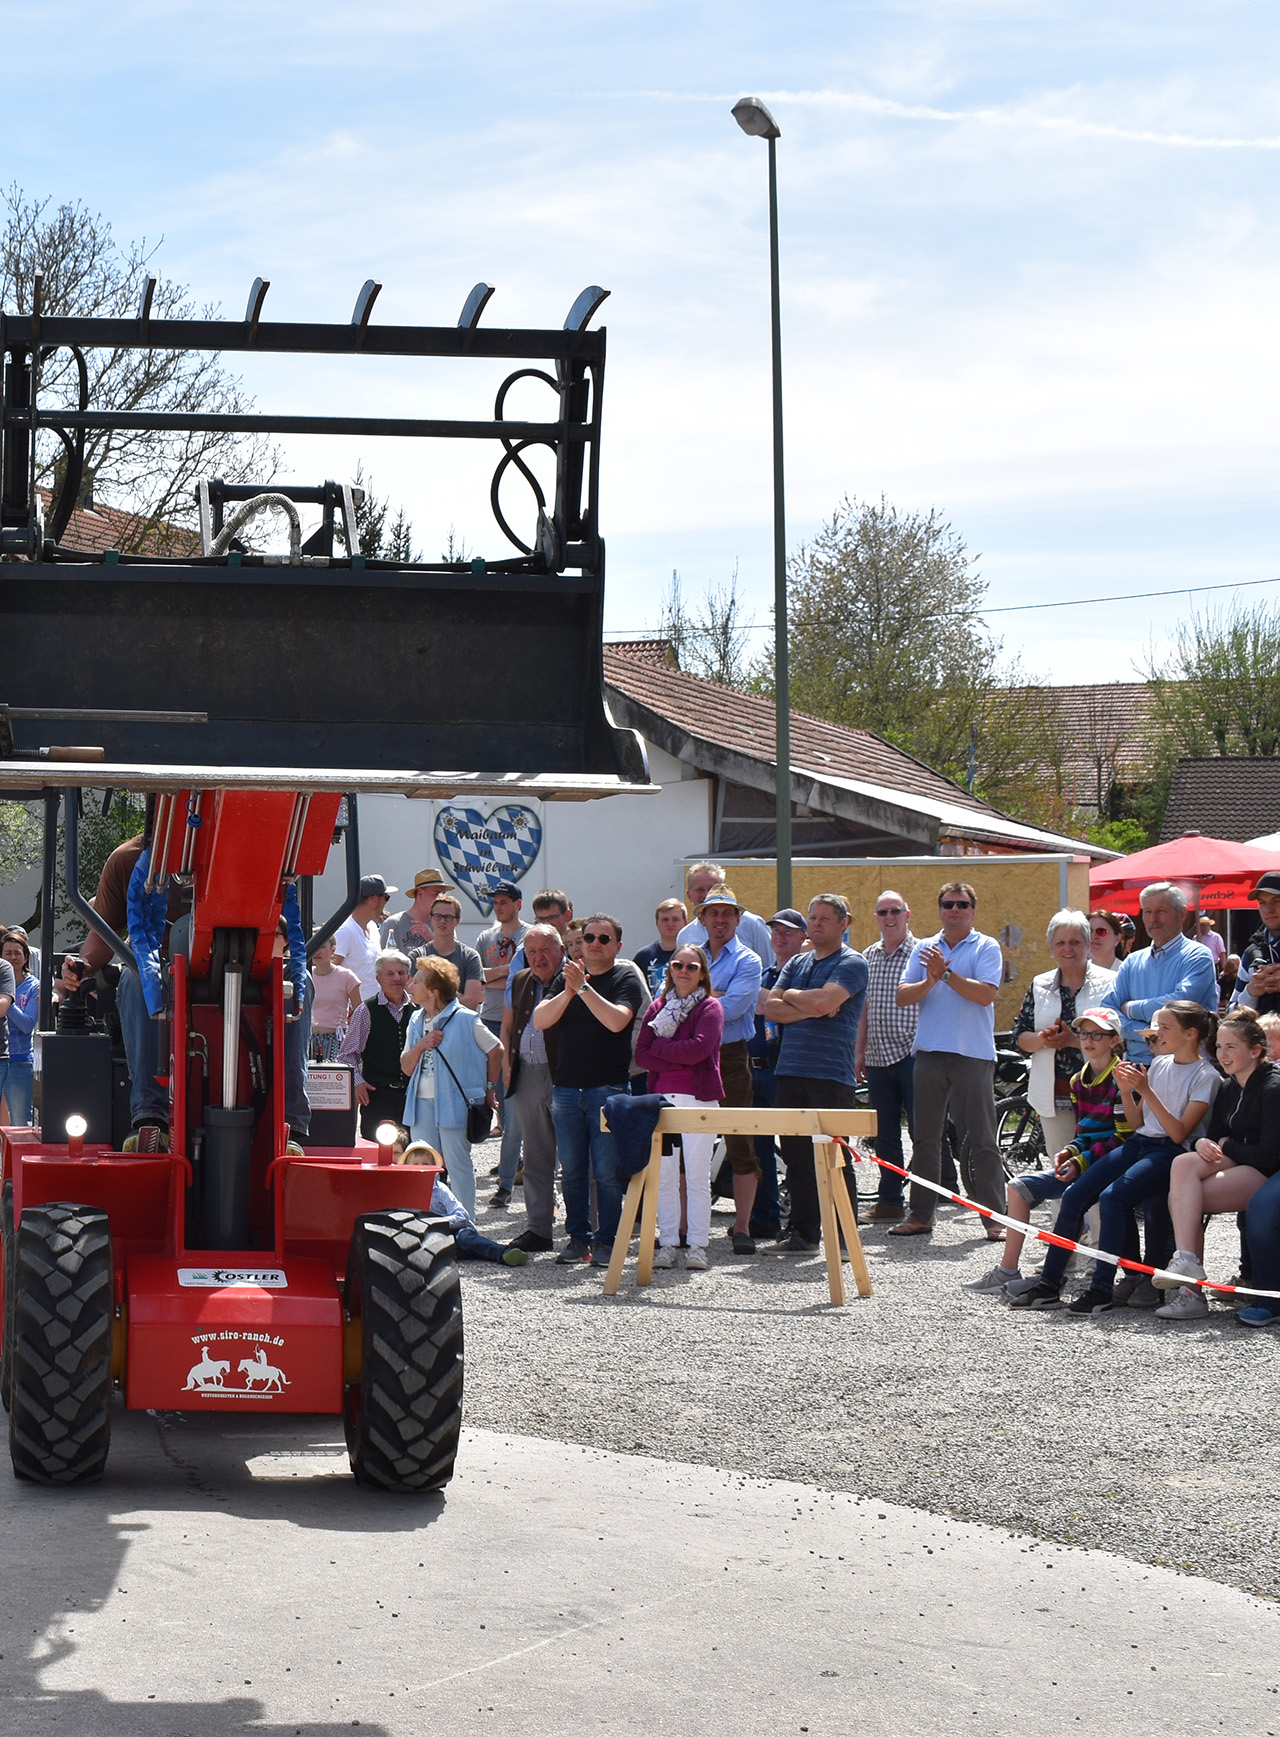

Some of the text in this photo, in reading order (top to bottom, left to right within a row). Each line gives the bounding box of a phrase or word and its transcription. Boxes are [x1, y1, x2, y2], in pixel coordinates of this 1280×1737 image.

[454, 828, 517, 840] Maibaum
[480, 846, 491, 857] in
[453, 861, 518, 874] Schwillach
[191, 1330, 285, 1347] www.siro-ranch.de
